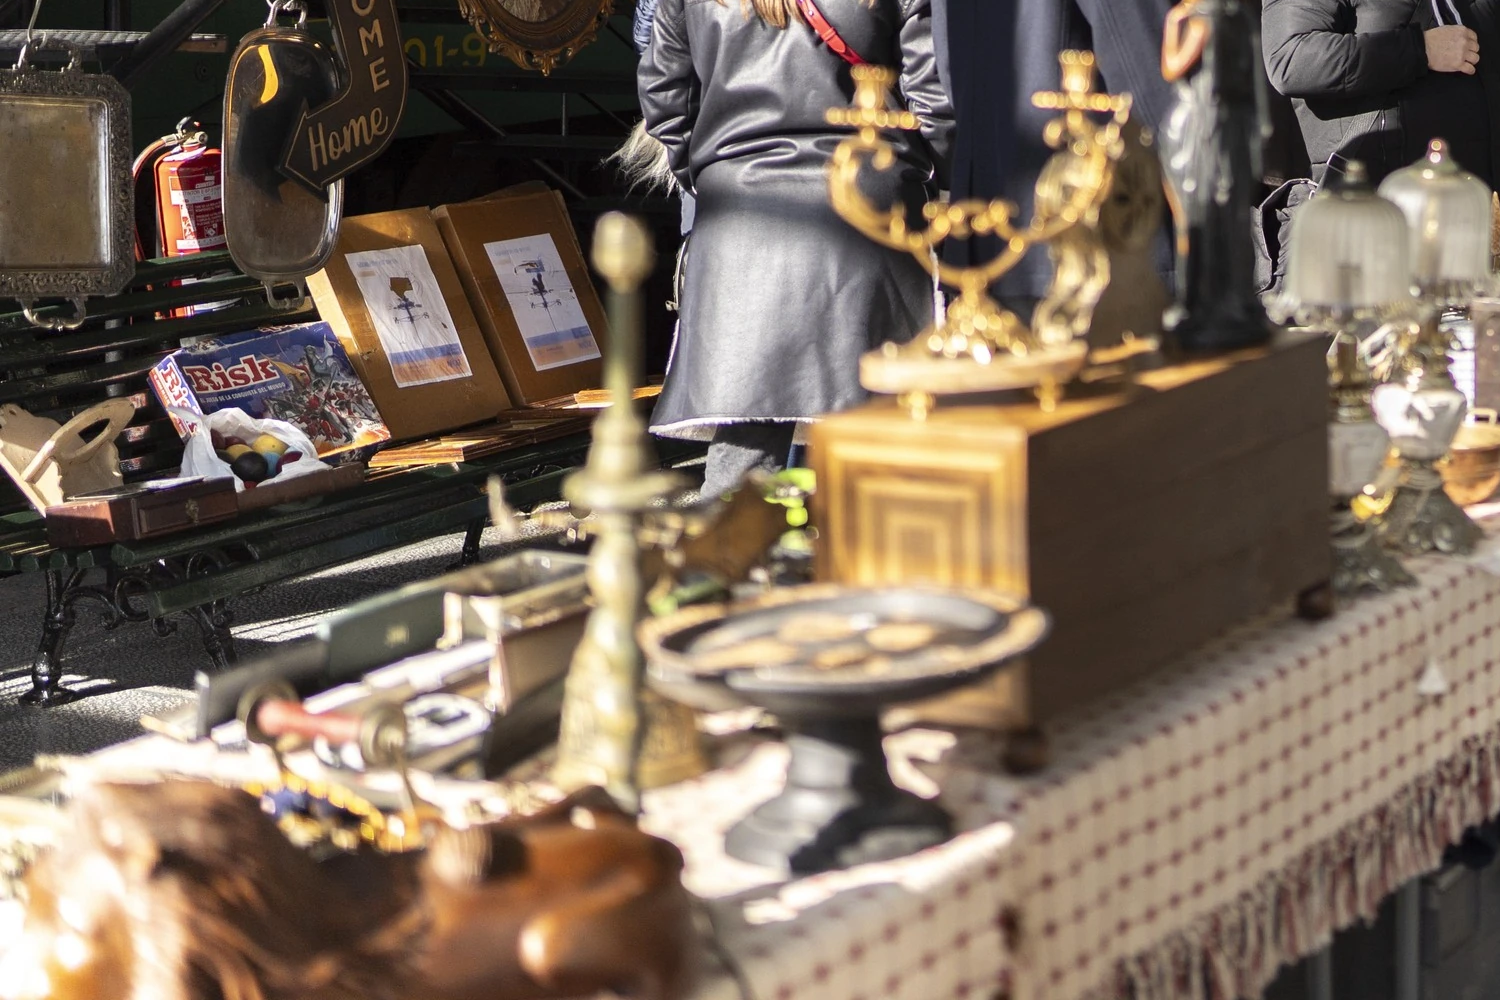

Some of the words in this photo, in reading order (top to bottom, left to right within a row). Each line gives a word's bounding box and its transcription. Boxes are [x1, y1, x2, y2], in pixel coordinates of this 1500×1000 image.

[308, 107, 388, 171] Home
[184, 356, 278, 392] Risk
[231, 389, 257, 399] CONQUISTA
[267, 382, 286, 391] MUNDO
